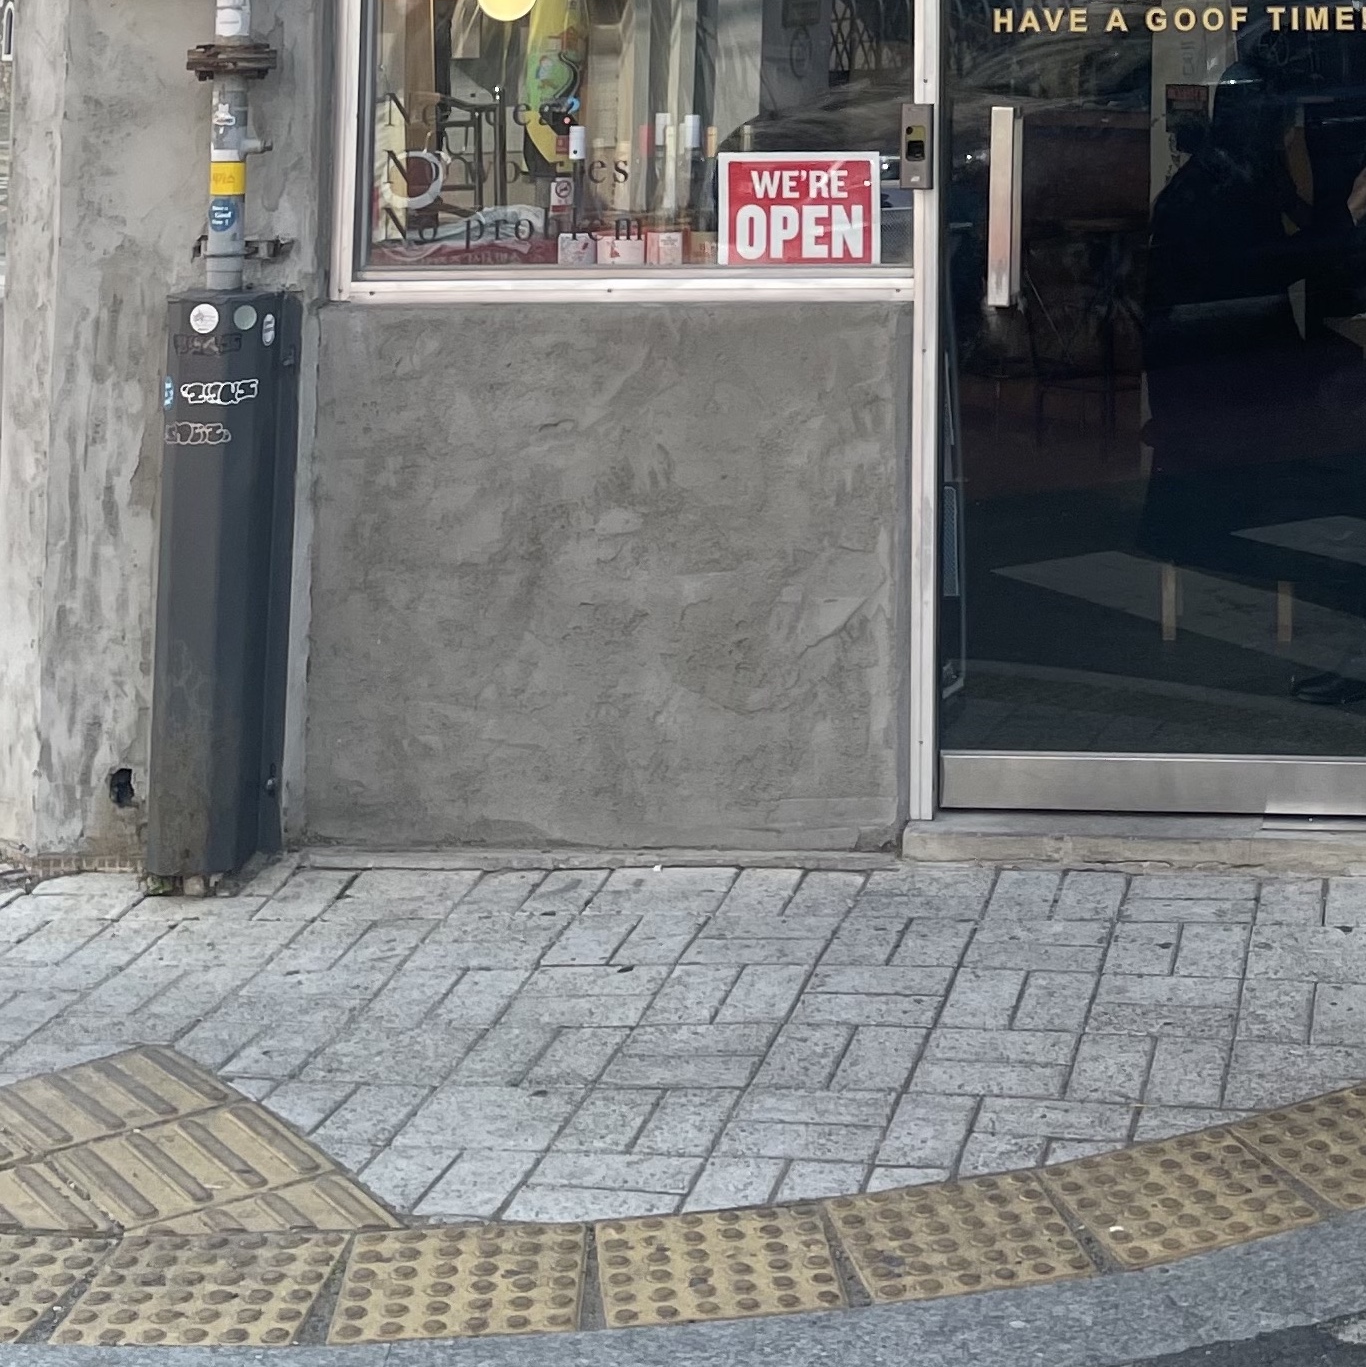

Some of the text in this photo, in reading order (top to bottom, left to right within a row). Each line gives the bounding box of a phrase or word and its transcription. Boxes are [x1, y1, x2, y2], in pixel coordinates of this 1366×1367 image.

[994, 8, 1088, 33] HAVE
[1106, 8, 1129, 32] A
[1146, 7, 1249, 32] GOOF
[750, 170, 848, 198] WE'RE
[736, 204, 864, 260] OPEN
